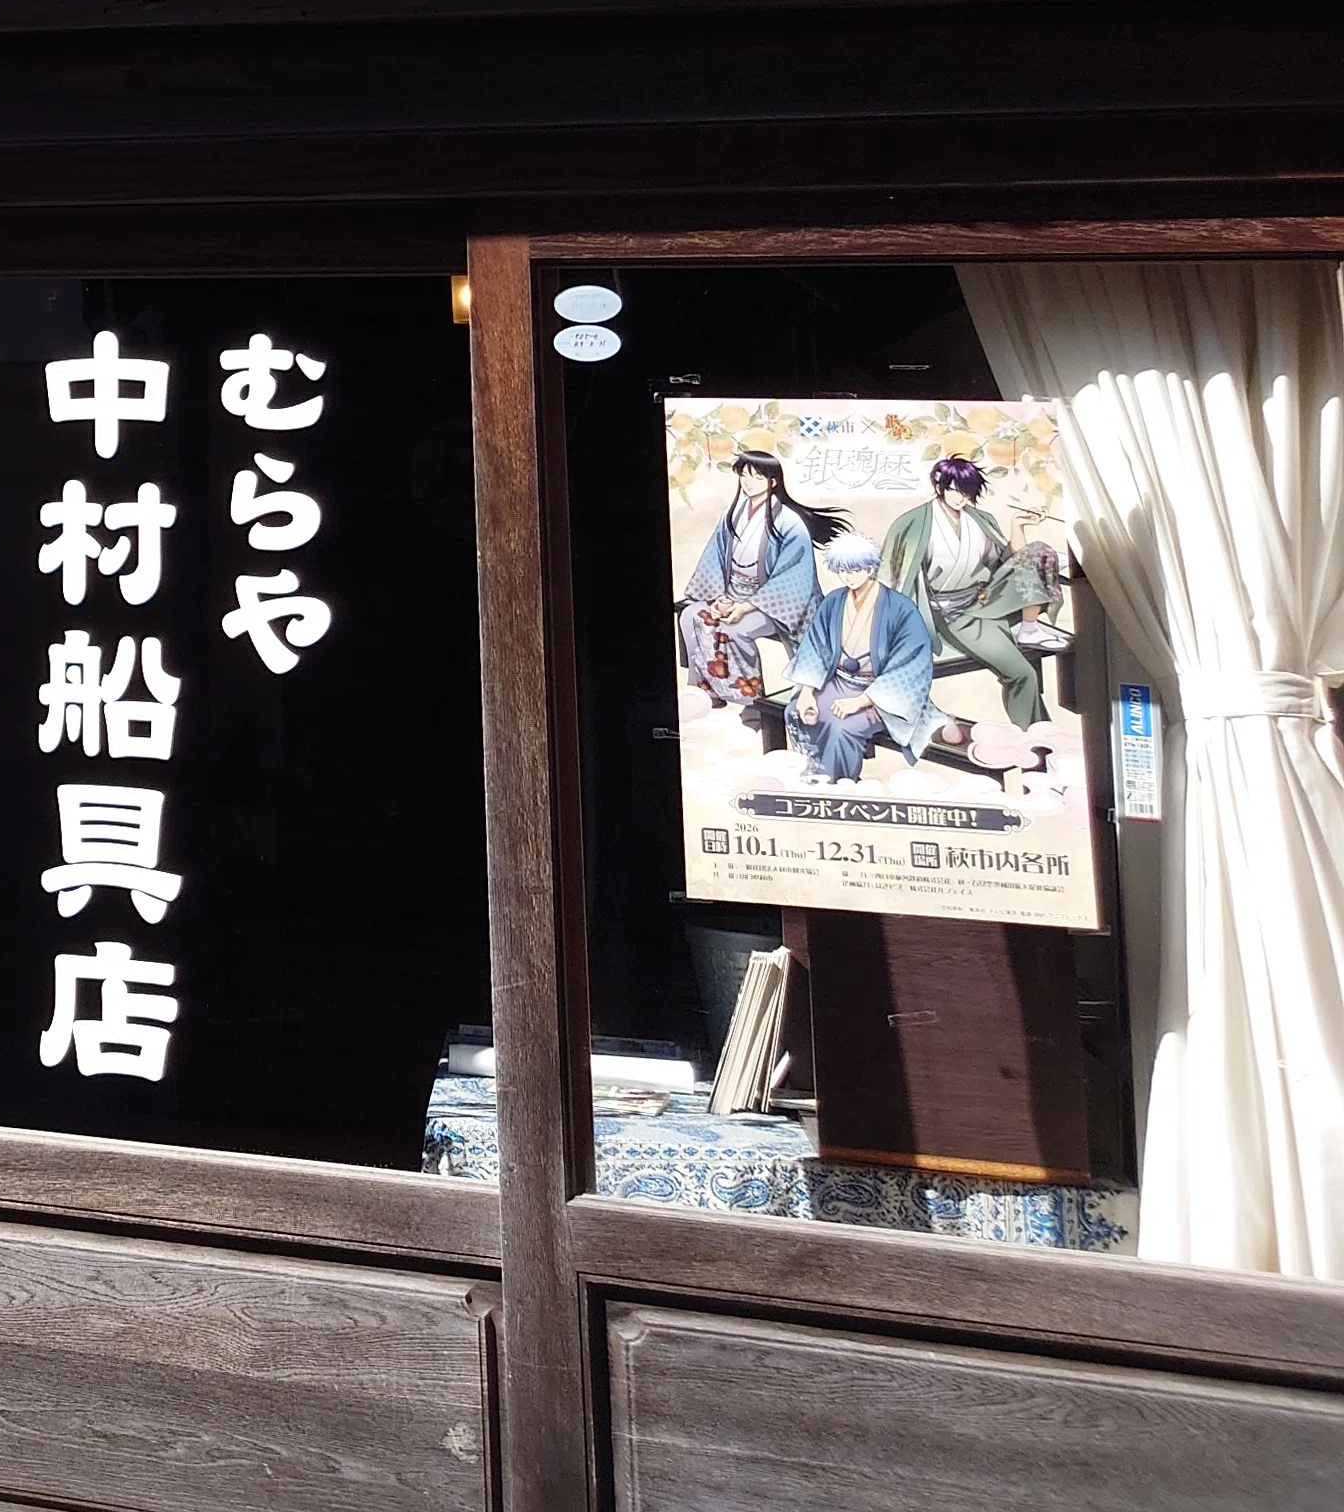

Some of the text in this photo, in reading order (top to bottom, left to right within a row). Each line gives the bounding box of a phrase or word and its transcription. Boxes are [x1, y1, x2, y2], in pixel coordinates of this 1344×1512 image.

[219, 333, 332, 675] むらや
[38, 330, 182, 1083] 中村船具店
[775, 798, 978, 827] コラボイベント開催中!
[734, 823, 759, 833] 2026
[944, 846, 1070, 876] 萩市内各所
